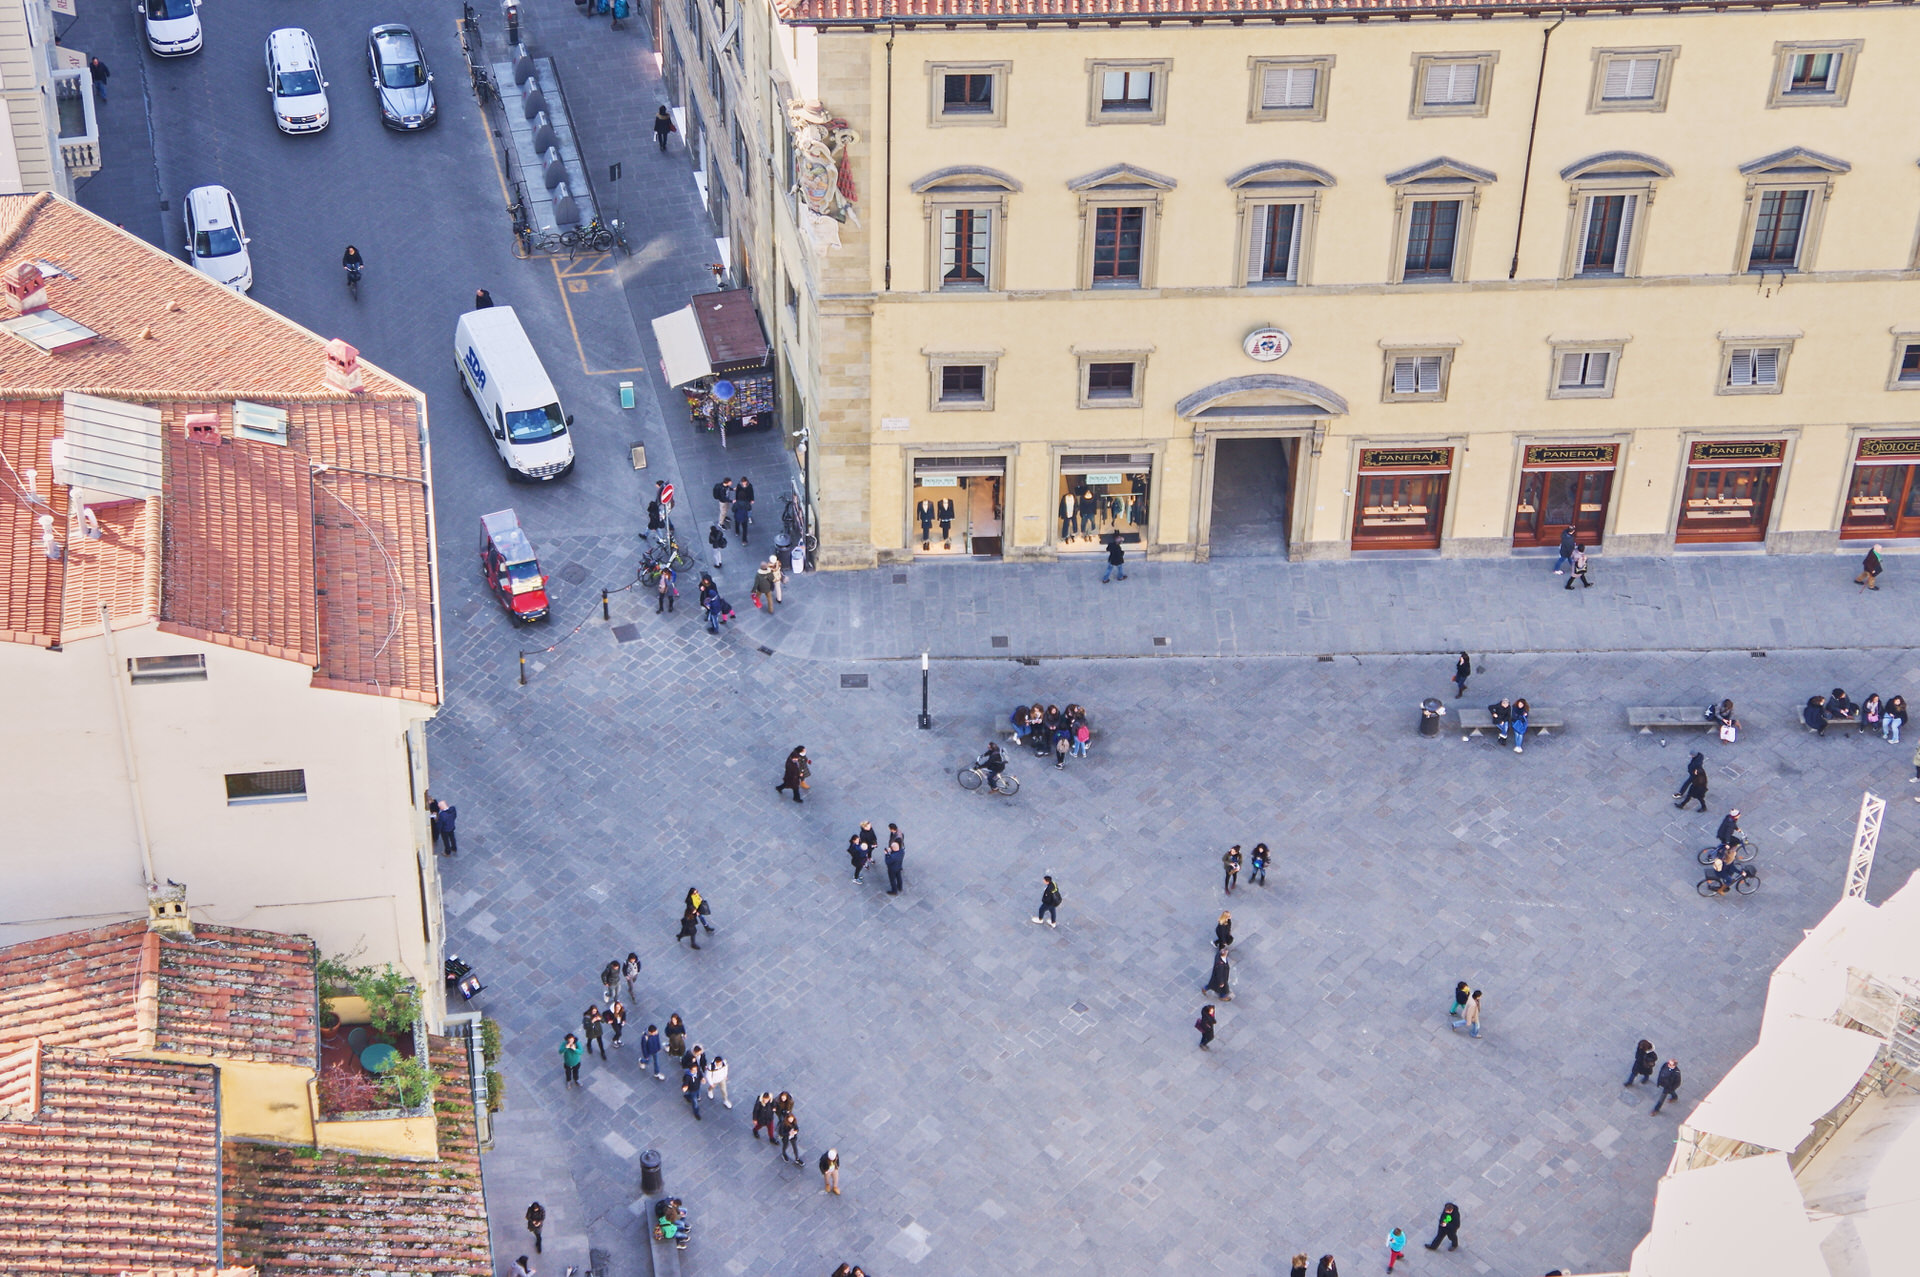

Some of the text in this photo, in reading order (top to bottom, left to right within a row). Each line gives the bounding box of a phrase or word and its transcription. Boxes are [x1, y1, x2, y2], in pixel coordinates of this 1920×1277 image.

[466, 345, 486, 391] SDA
[1543, 450, 1599, 458] PANERAI
[1709, 446, 1766, 454] PANERAI
[1378, 454, 1434, 462] PANERAI
